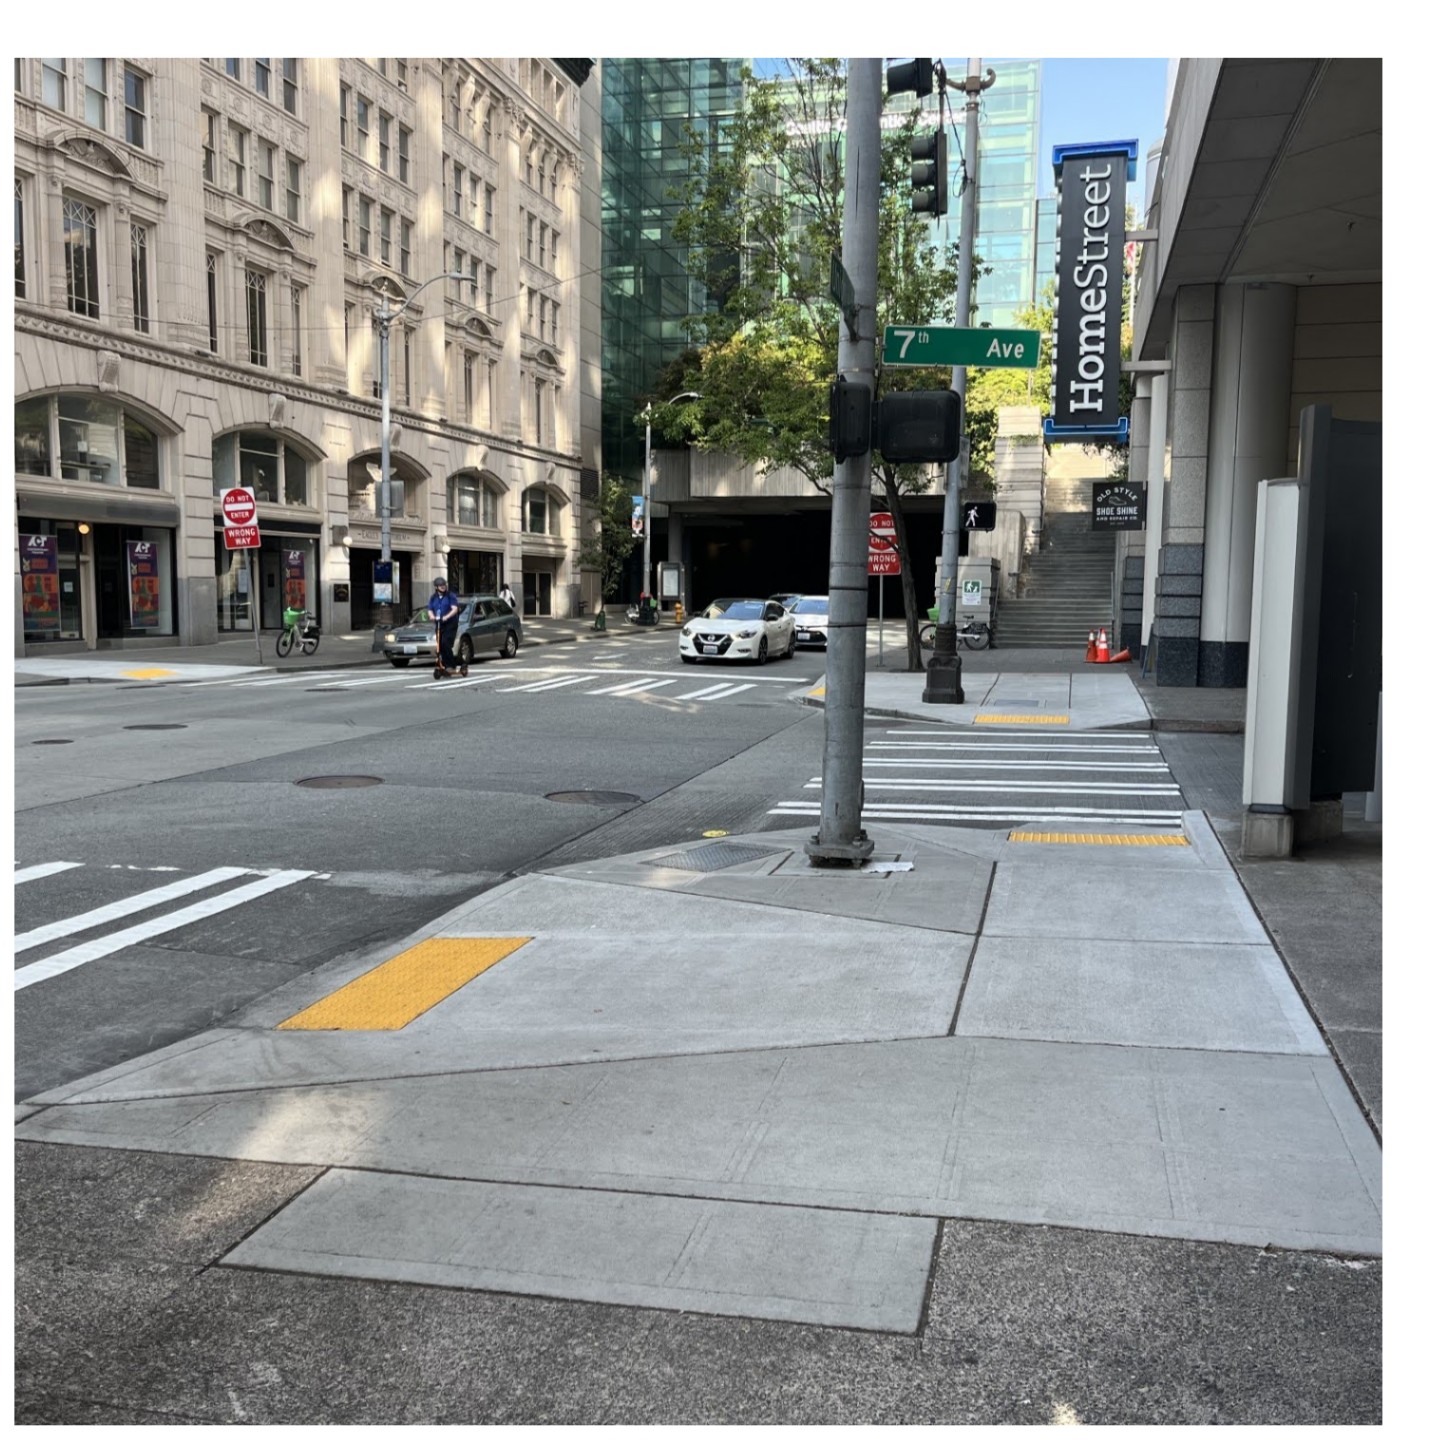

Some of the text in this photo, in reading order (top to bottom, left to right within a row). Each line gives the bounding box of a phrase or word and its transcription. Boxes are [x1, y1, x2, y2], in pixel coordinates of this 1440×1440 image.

[1070, 163, 1111, 413] HomeStreet
[893, 330, 1024, 359] 7th Ave
[1096, 487, 1138, 502] OLD STYLE
[1096, 506, 1138, 515] SHOE SHINE
[228, 528, 255, 537] WRONG
[28, 536, 47, 547] ACT
[235, 537, 251, 545] WAY
[135, 542, 150, 553] ACT
[872, 564, 890, 572] WAY
